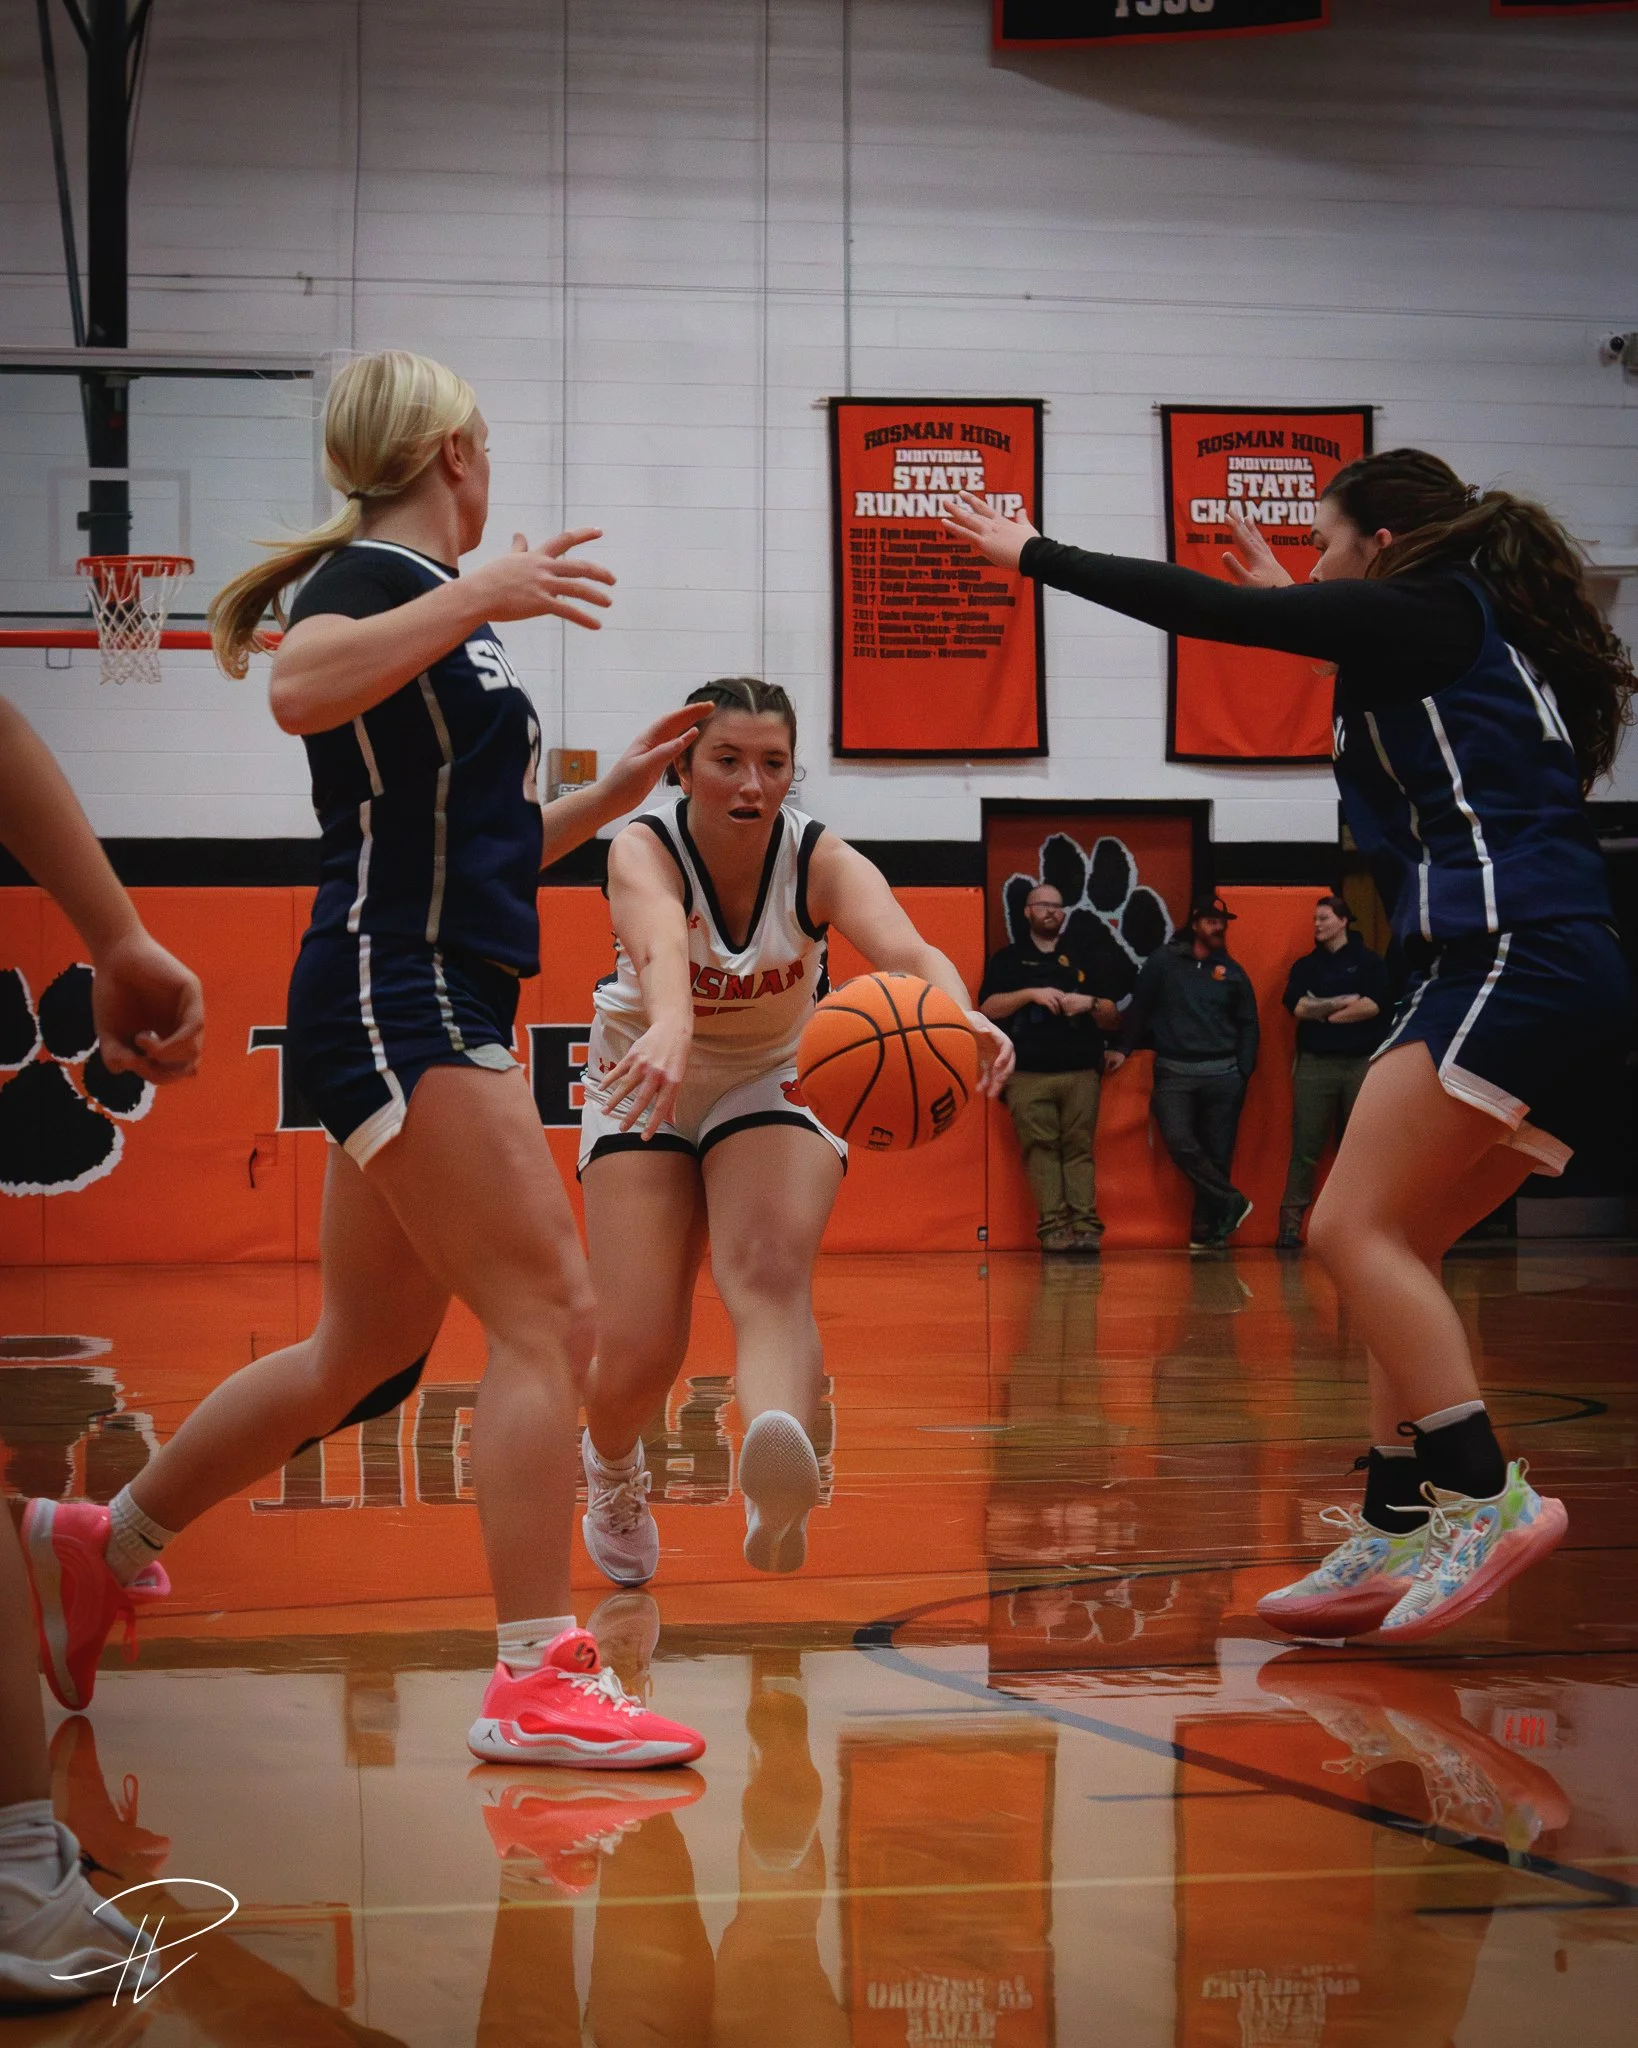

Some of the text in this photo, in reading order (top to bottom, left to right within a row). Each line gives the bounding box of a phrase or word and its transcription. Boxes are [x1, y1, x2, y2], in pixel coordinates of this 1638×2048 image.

[864, 422, 1011, 453] ROSMAN HIGH
[1197, 430, 1341, 461] ROSMAN HIGH
[895, 449, 983, 463] INDIVIDUAL
[1228, 457, 1313, 471] INDIVIDUAL
[893, 466, 985, 491] STATE
[1227, 473, 1316, 498] STATE
